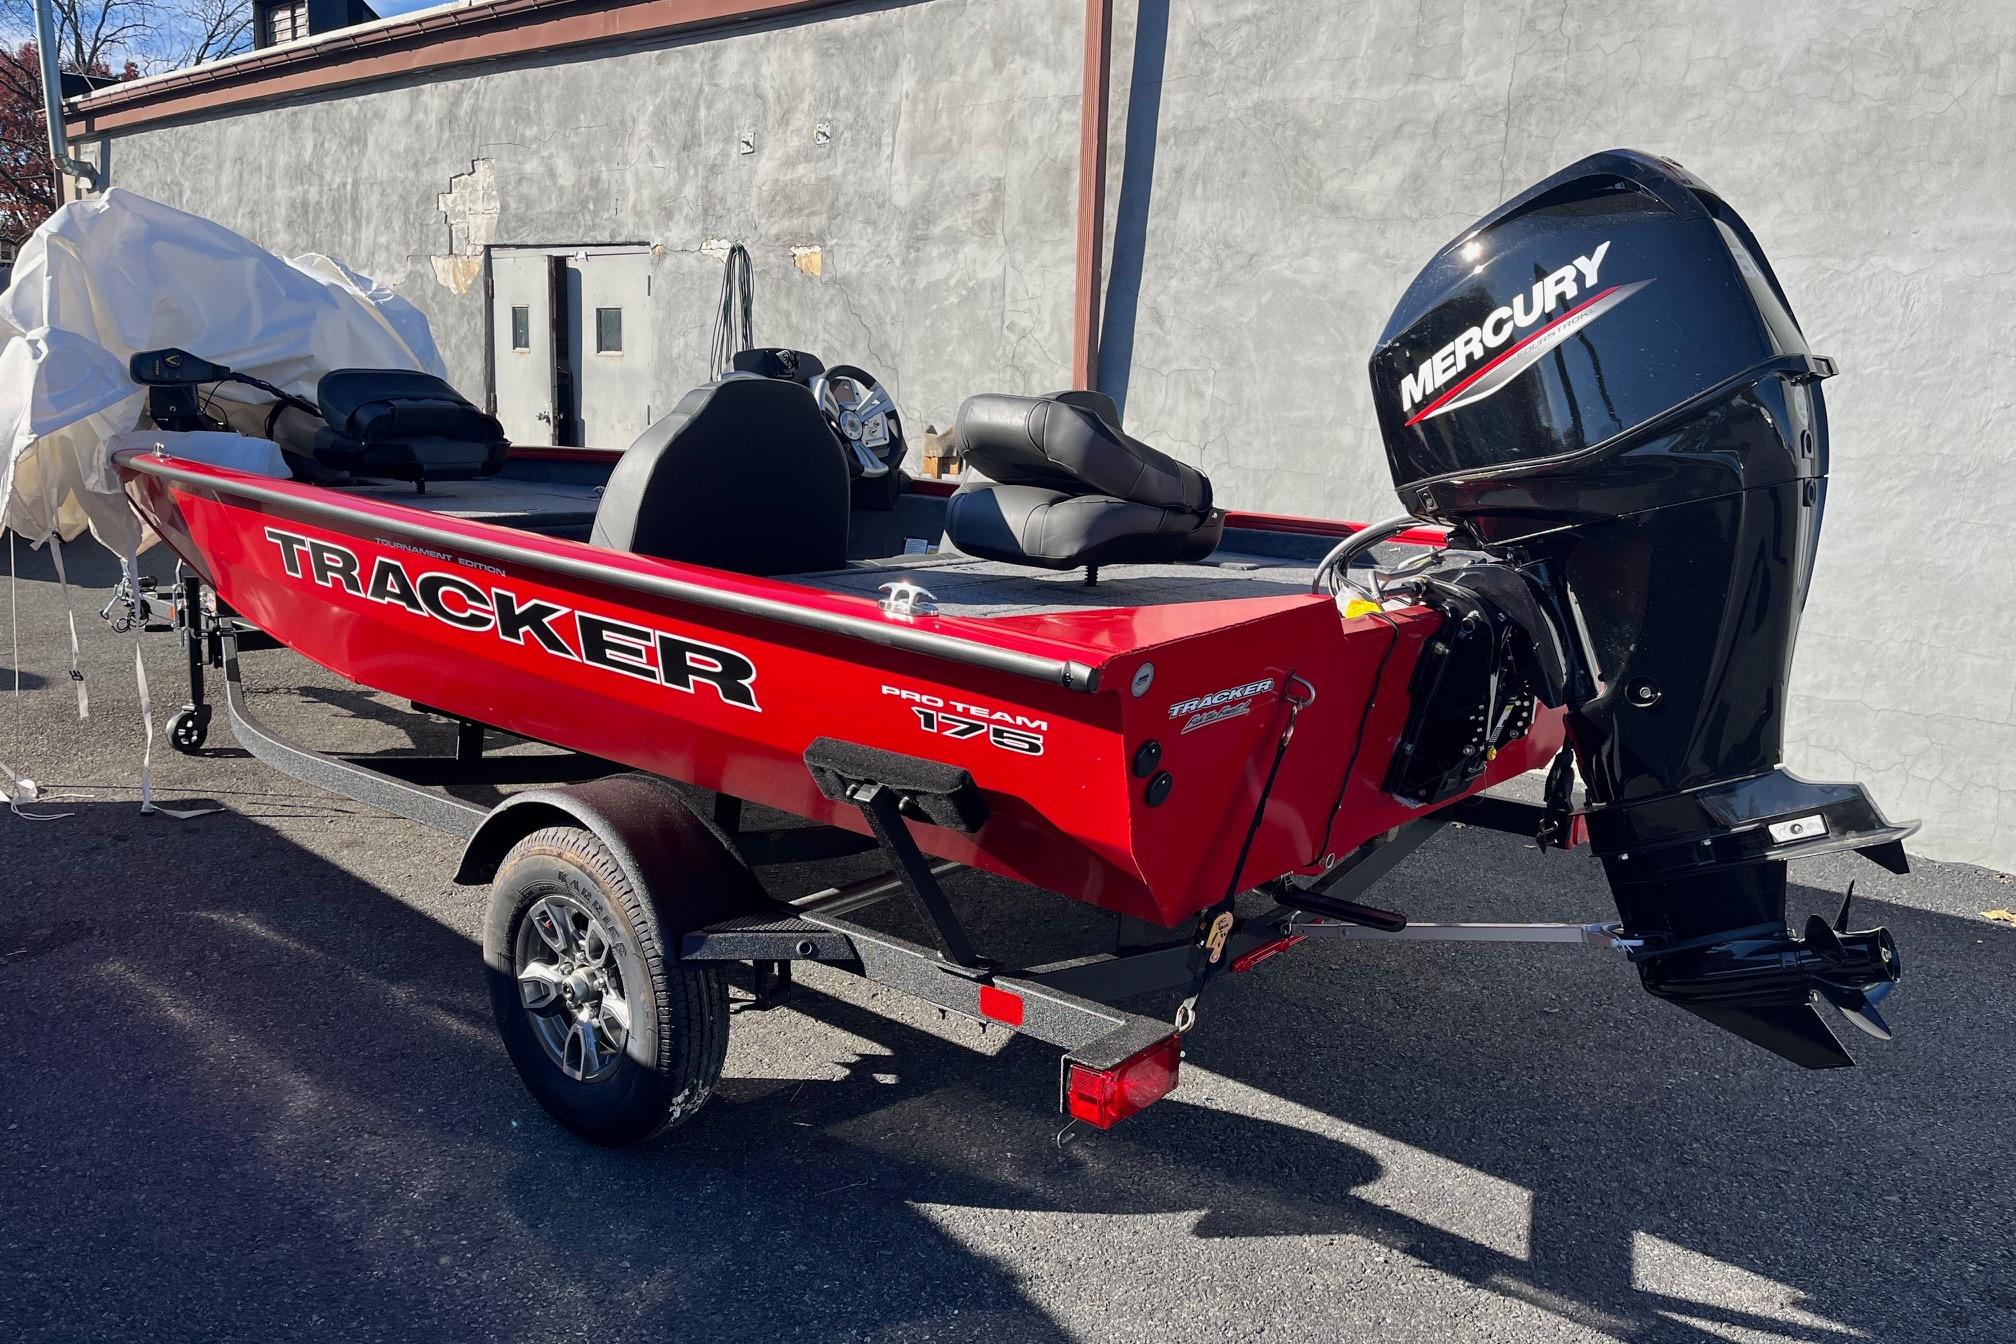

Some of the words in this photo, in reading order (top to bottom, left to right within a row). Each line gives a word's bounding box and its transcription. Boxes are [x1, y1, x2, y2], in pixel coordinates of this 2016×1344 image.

[1401, 241, 1611, 412] MERCURY
[1516, 306, 1597, 359] FOURSTROKE
[374, 536, 453, 562] TOURNAMENT
[457, 557, 506, 577] EDITION
[264, 526, 763, 713] TRACKER
[881, 684, 944, 709] PRO
[953, 700, 1048, 732] TEAM
[1169, 678, 1273, 719] TRACKER
[911, 705, 1045, 757] 175
